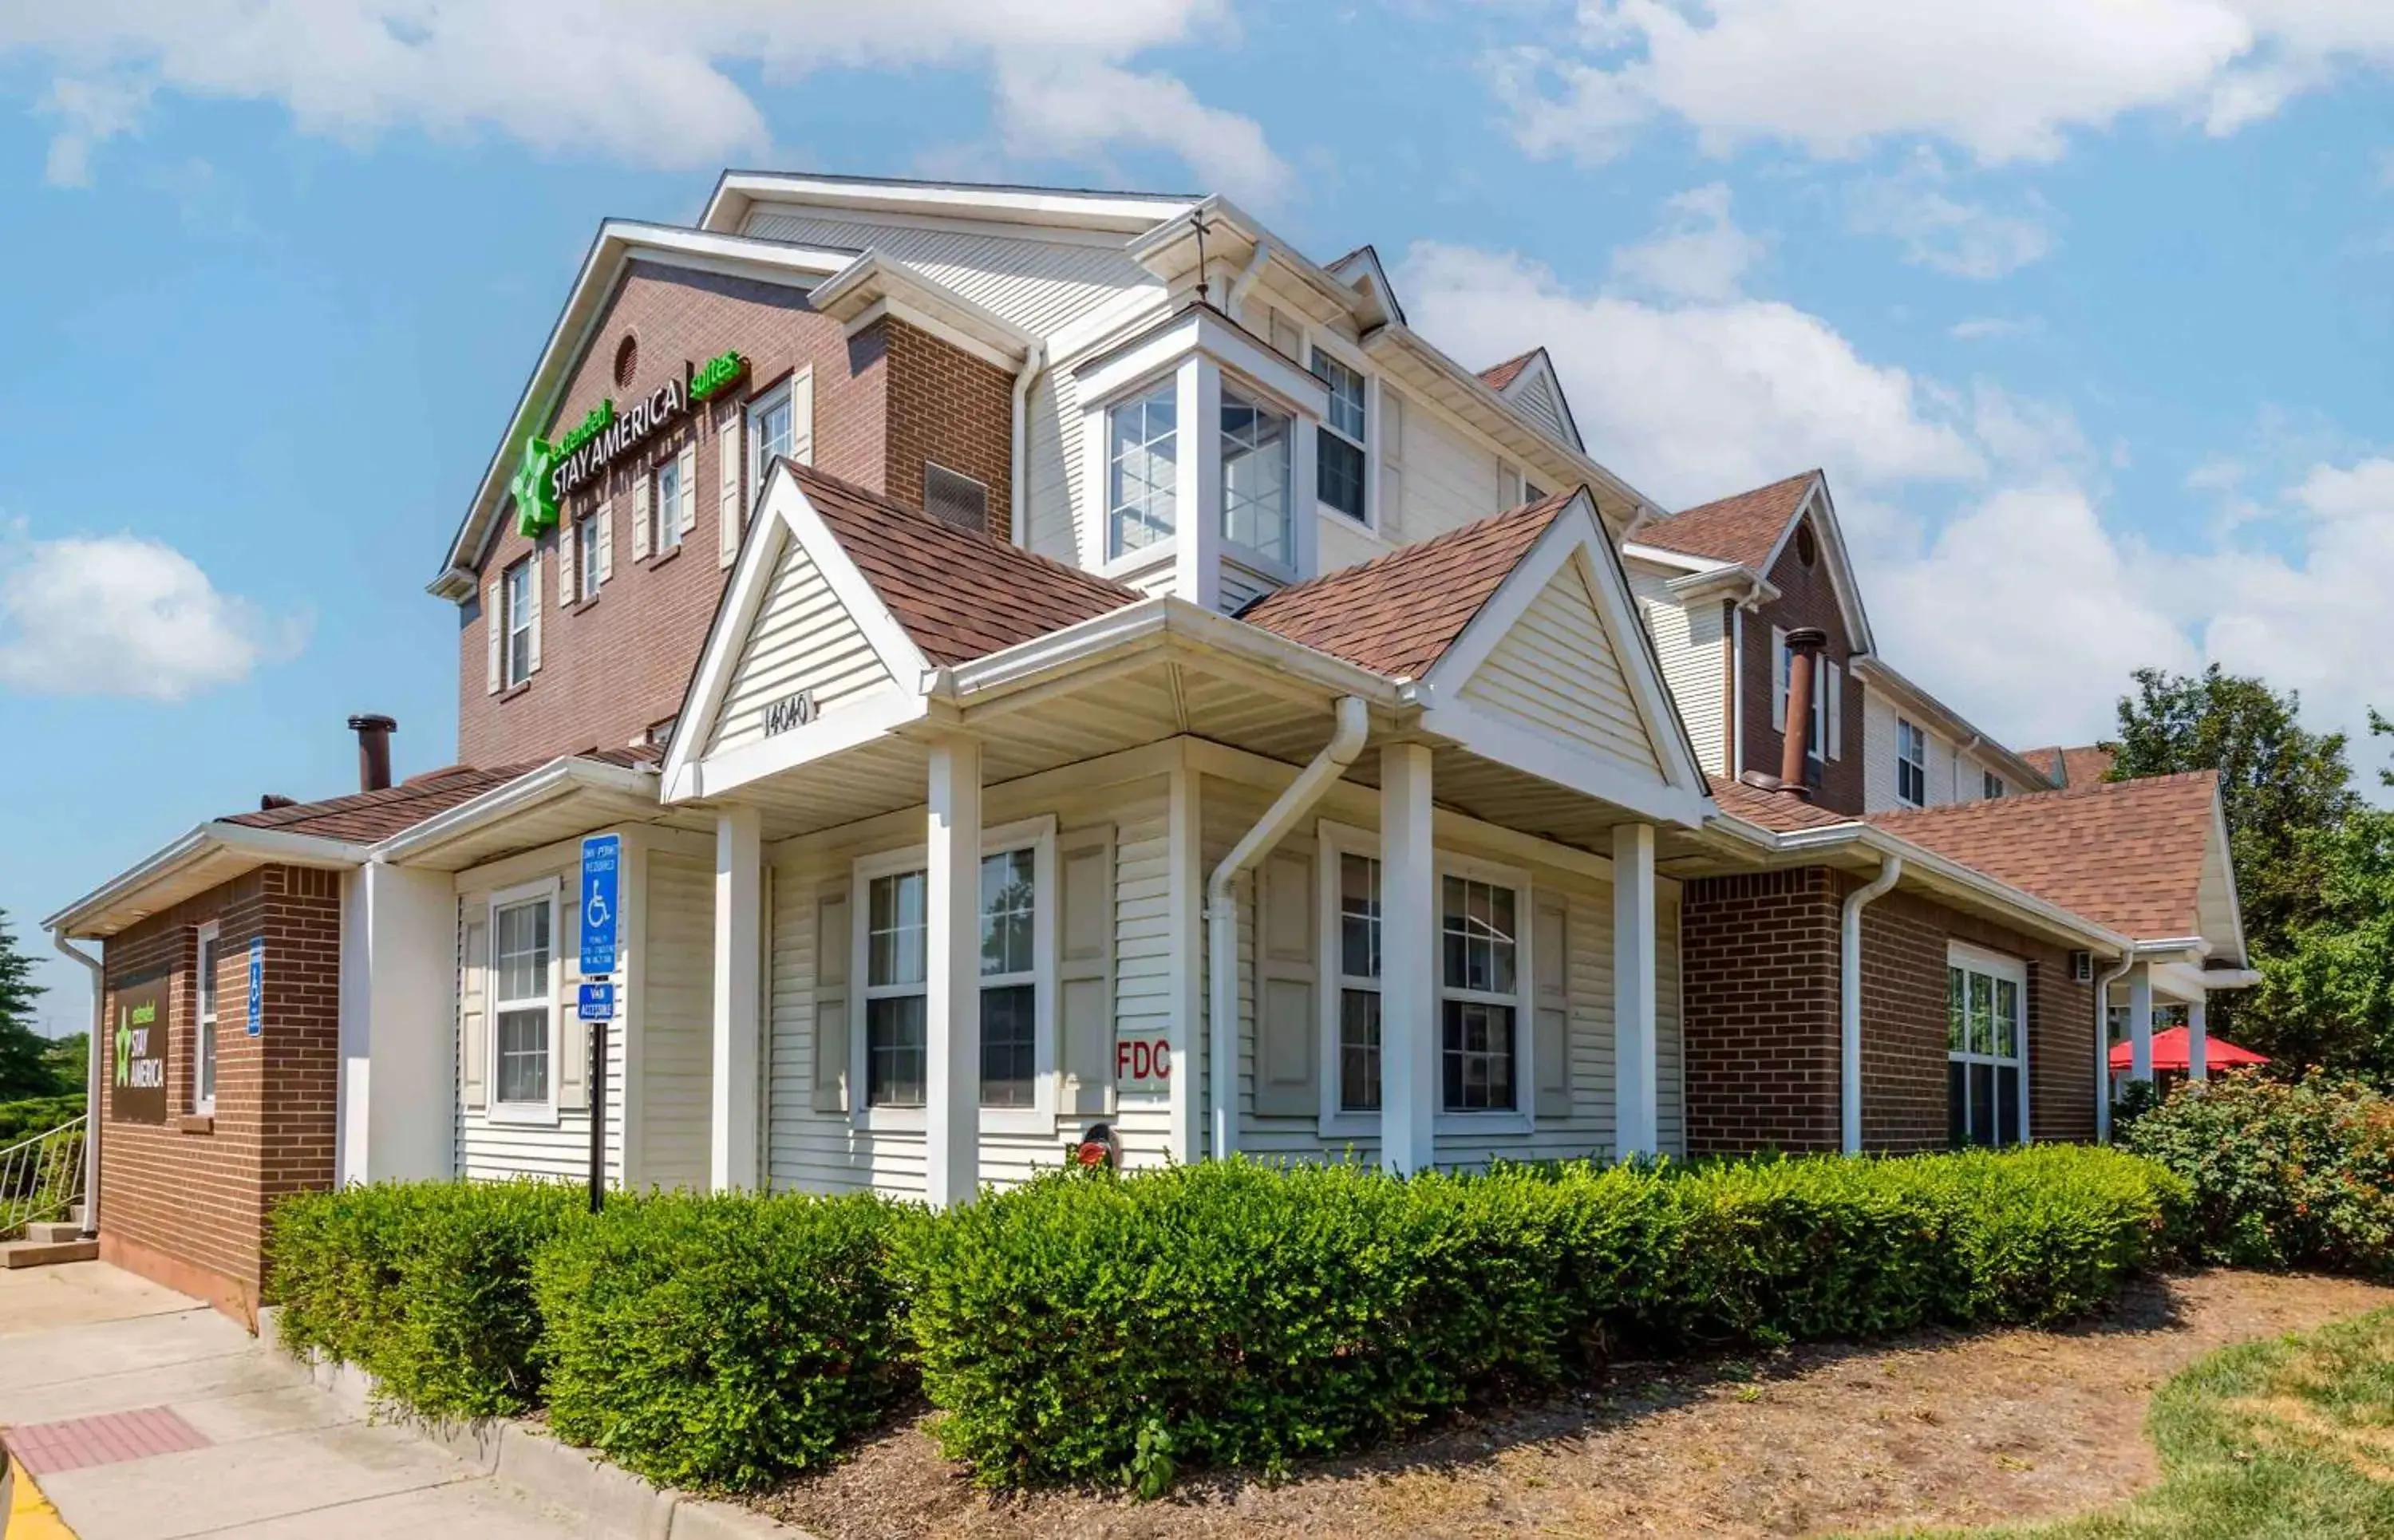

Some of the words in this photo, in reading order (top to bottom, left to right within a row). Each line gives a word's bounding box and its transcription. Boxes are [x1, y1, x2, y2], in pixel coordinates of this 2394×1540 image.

[689, 352, 737, 398] suites
[552, 398, 610, 462] extended
[765, 693, 808, 736] 14040
[1117, 1040, 1171, 1079] FDC
